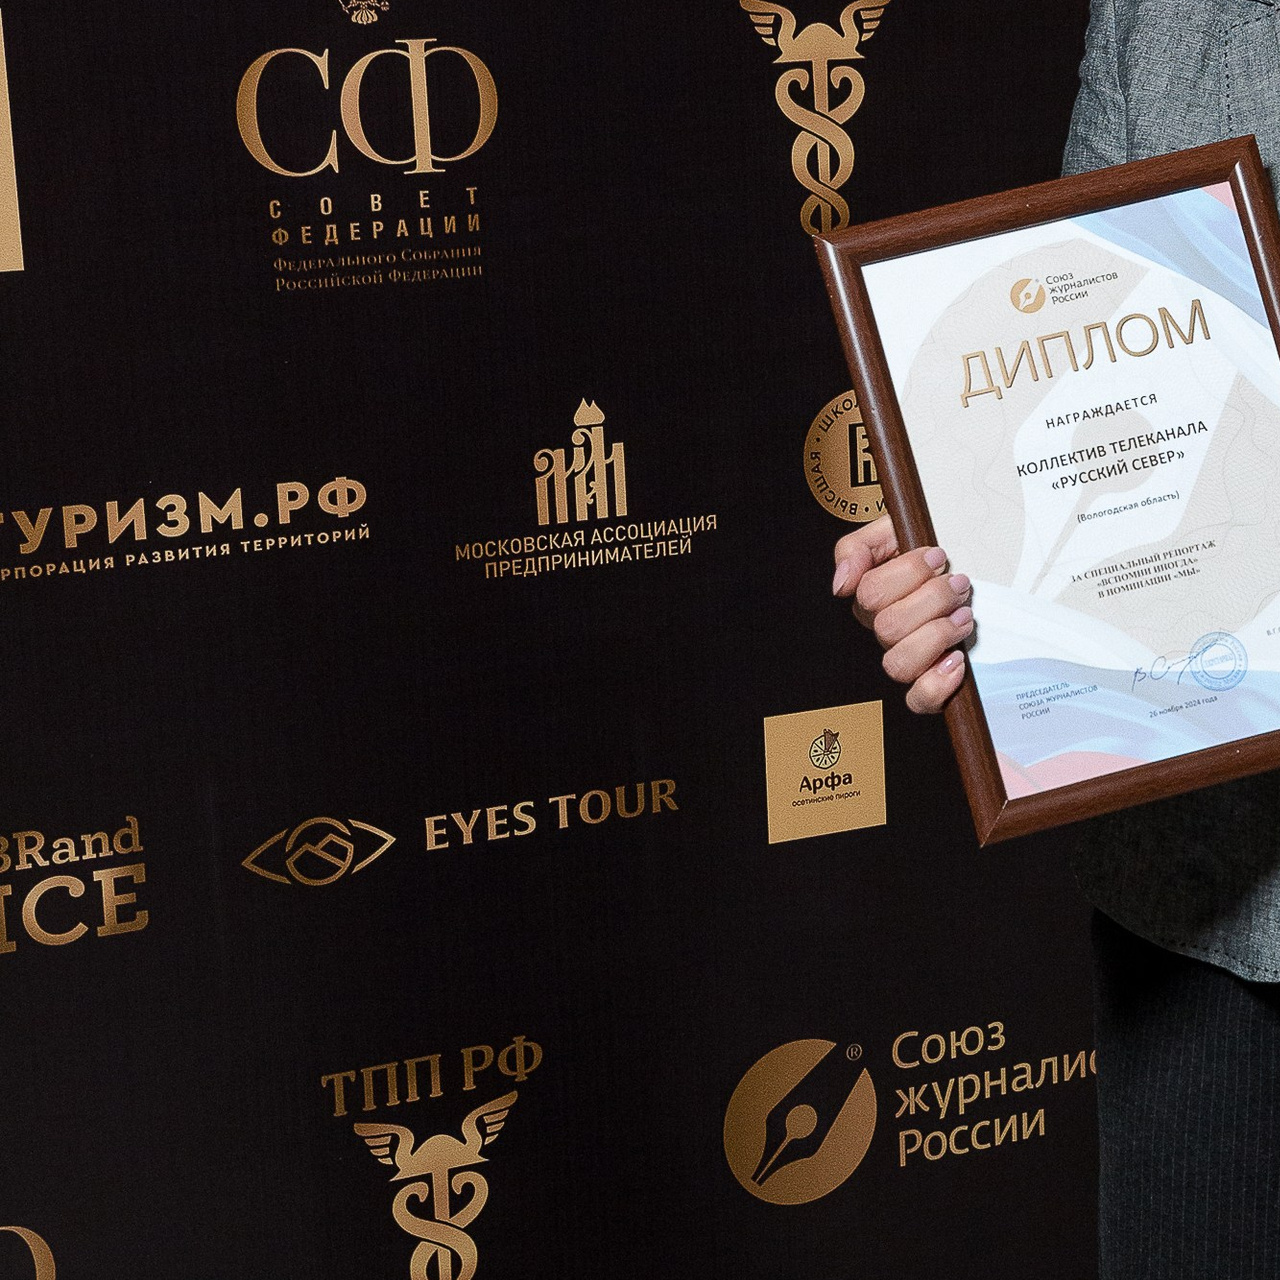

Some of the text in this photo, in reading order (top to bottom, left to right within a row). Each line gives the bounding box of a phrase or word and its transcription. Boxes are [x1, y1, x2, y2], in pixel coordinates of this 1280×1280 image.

[235, 37, 499, 178] СФ
[268, 186, 478, 219] СОВЕТ
[271, 213, 481, 246] ФЕДЕРАЦИИ
[1045, 271, 1074, 285] Союз
[1049, 271, 1119, 294] журналистов
[1052, 290, 1089, 305] России
[960, 298, 1211, 408] ДИПЛОМ
[819, 398, 859, 432] ШКО
[1045, 392, 1159, 429] НАГРАЖДАЕТСЯ
[1016, 420, 1208, 477] КОЛЛЕКТИВ ТЕЛЕКАНАЛА
[1051, 448, 1186, 491] «РУССКИЙ СЕВЕР»
[0, 476, 367, 555] УРИЗМ.РФ
[1077, 490, 1181, 524] (Вологодская область)
[125, 542, 231, 567] РАЗВИТИЯ
[240, 523, 371, 554] ТЕРРИТОРИЙ
[454, 514, 718, 561] МОСКОВСКАЯ АССОЦИАЦИЯ
[484, 534, 693, 579] ПРЕДПРИНИМАТЕЛЕЙ
[1084, 553, 1162, 580] СПЕЦИАЛЬНЫЙ
[1162, 539, 1217, 560] РЕПОРТАЖ
[1106, 573, 1172, 597] НОМИНАЦИИ
[1016, 681, 1070, 701] ПРЕДСЕДАТЕЛЬ
[1046, 684, 1099, 703] ЖУРНАЛИСТОВ
[1184, 698, 1202, 710] 2024
[1202, 695, 1219, 707] года
[1021, 707, 1051, 720] РОССИИ
[799, 771, 853, 795] Арфа
[424, 777, 680, 852] EYES TOUR
[890, 1021, 1006, 1070] Союз
[321, 1034, 545, 1118] ТПП РФ
[898, 1108, 1046, 1168] России
